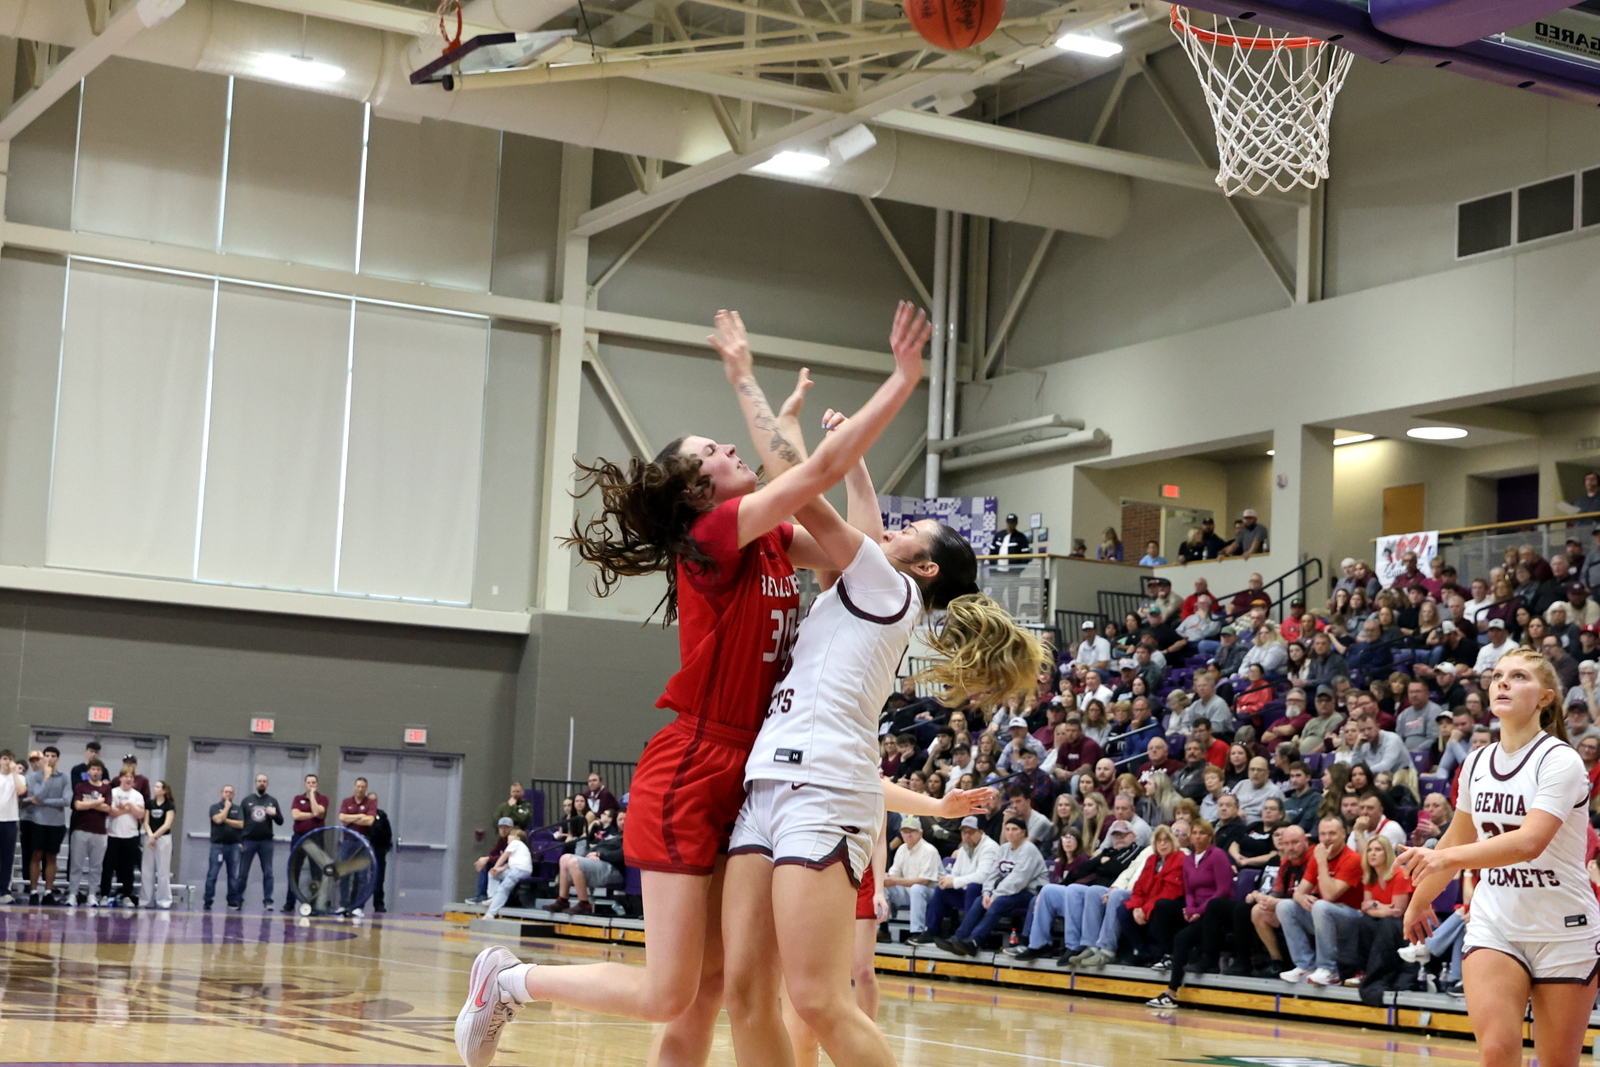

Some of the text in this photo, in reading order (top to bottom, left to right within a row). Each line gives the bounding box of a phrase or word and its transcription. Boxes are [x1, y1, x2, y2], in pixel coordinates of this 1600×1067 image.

[762, 608, 798, 663] 30
[1474, 791, 1528, 816] GENOA
[1487, 866, 1561, 888] COMETS
